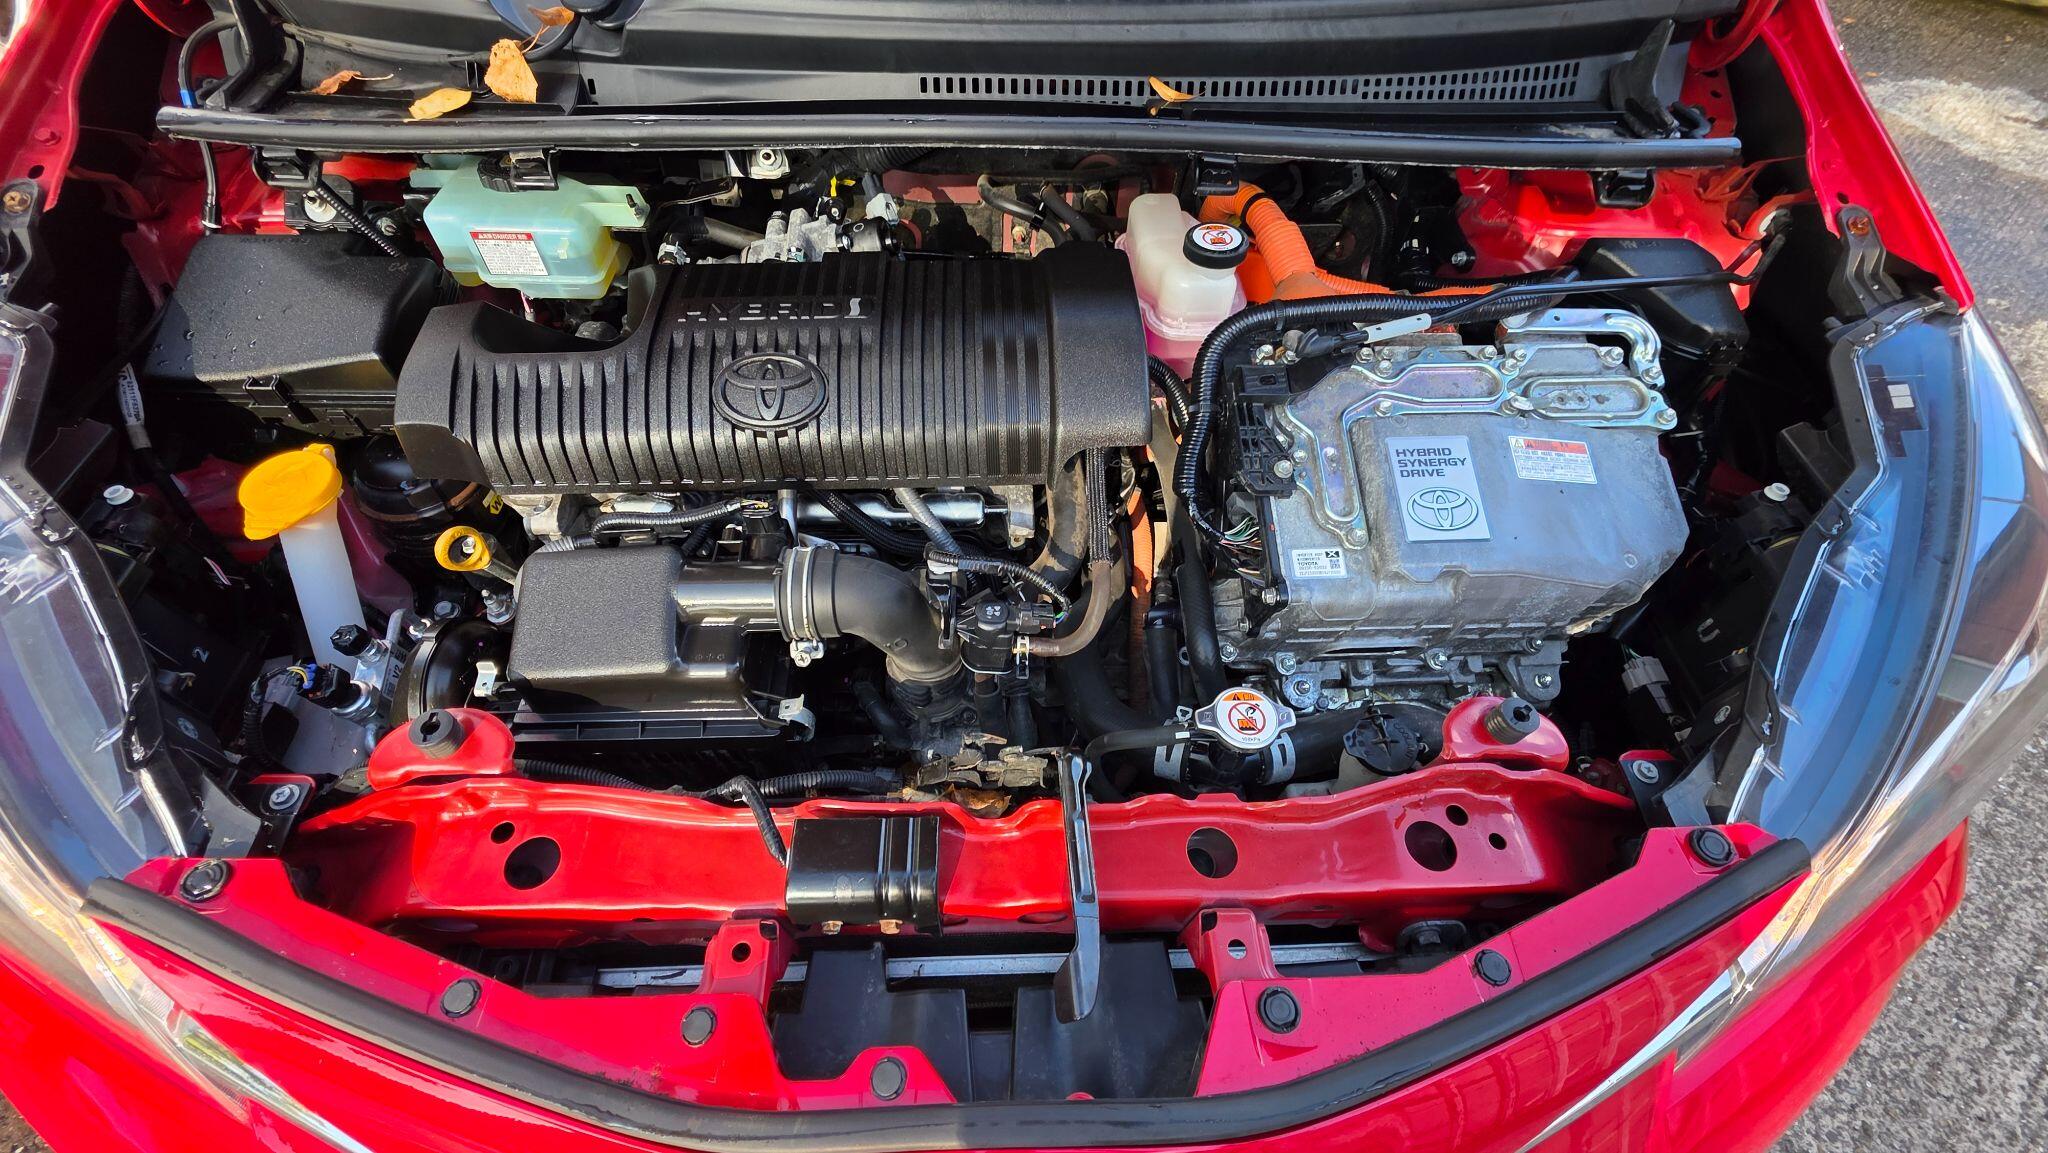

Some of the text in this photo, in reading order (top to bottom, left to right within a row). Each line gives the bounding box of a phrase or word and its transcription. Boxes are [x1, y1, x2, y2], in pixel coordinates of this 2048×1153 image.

[1395, 447, 1452, 457] HYBRID
[1397, 457, 1467, 468] SYNERGY
[1400, 468, 1445, 478] DRIVE
